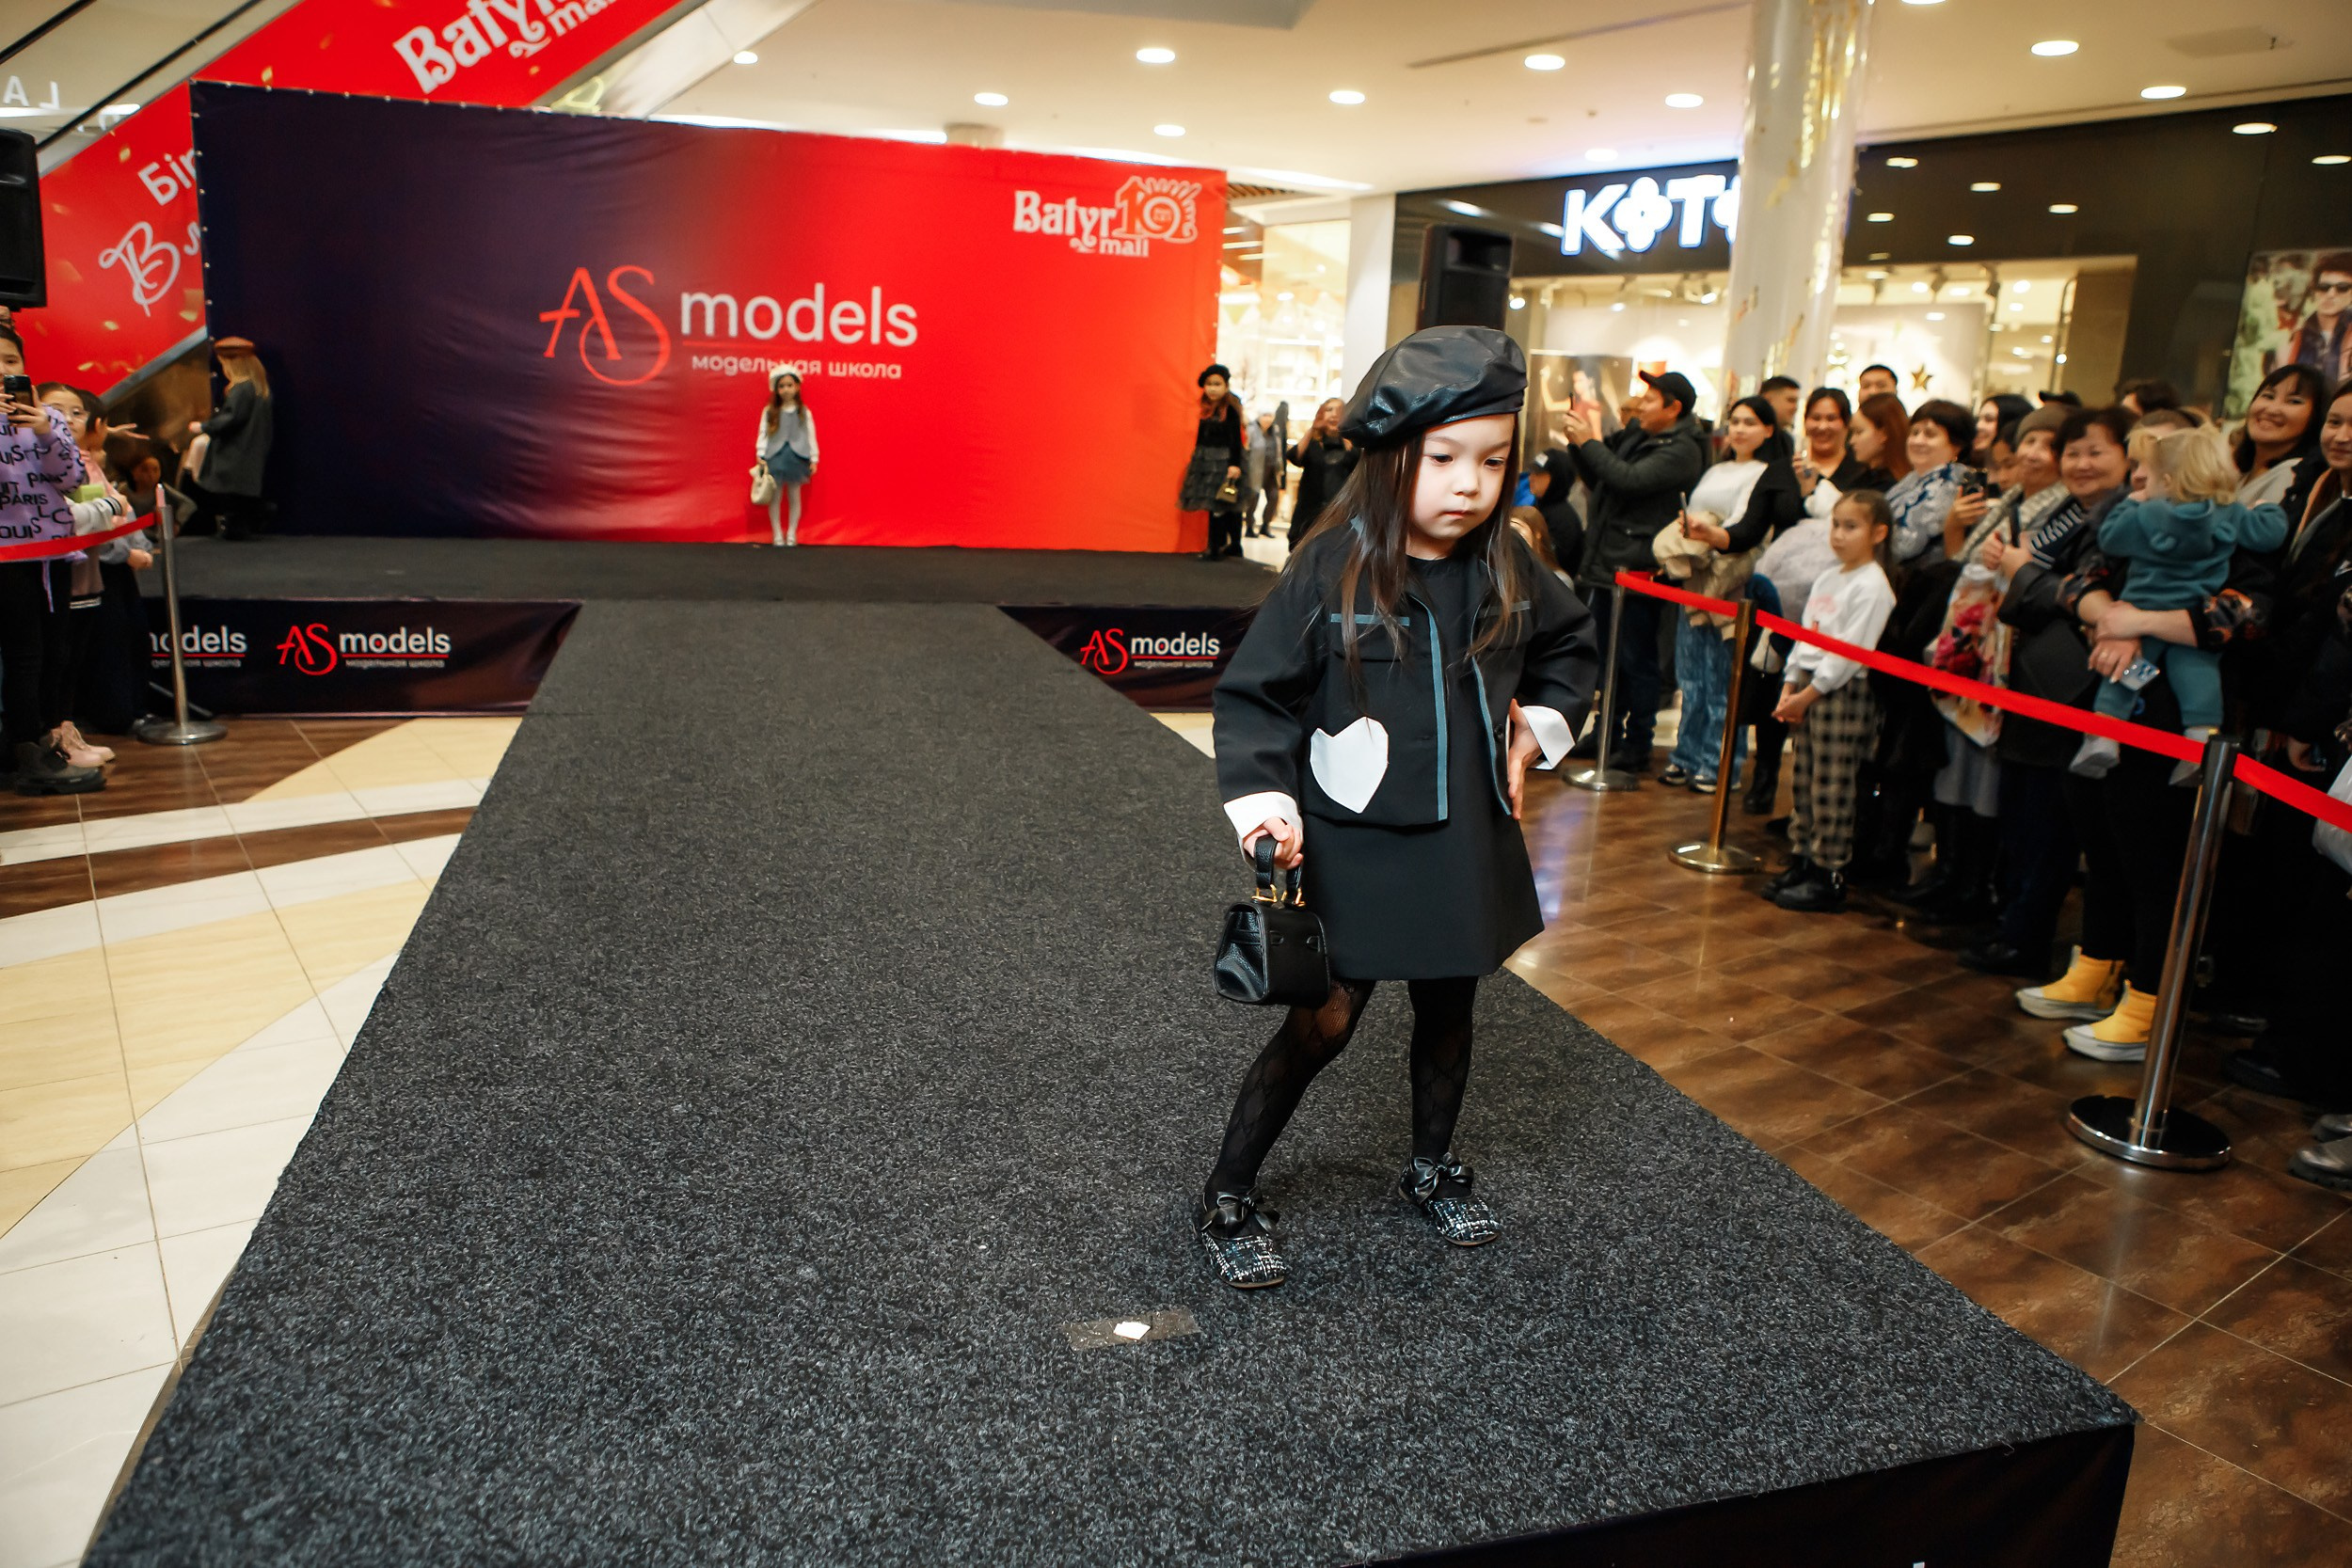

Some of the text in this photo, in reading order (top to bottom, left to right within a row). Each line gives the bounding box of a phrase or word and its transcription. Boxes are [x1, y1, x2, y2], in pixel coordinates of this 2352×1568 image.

[1013, 190, 1117, 250] Batyr
[1099, 237, 1150, 258] mall
[539, 264, 918, 387] AS models
[828, 360, 902, 379] школа
[277, 623, 338, 675] AS
[339, 626, 452, 653] models
[1080, 627, 1221, 674] AS models
